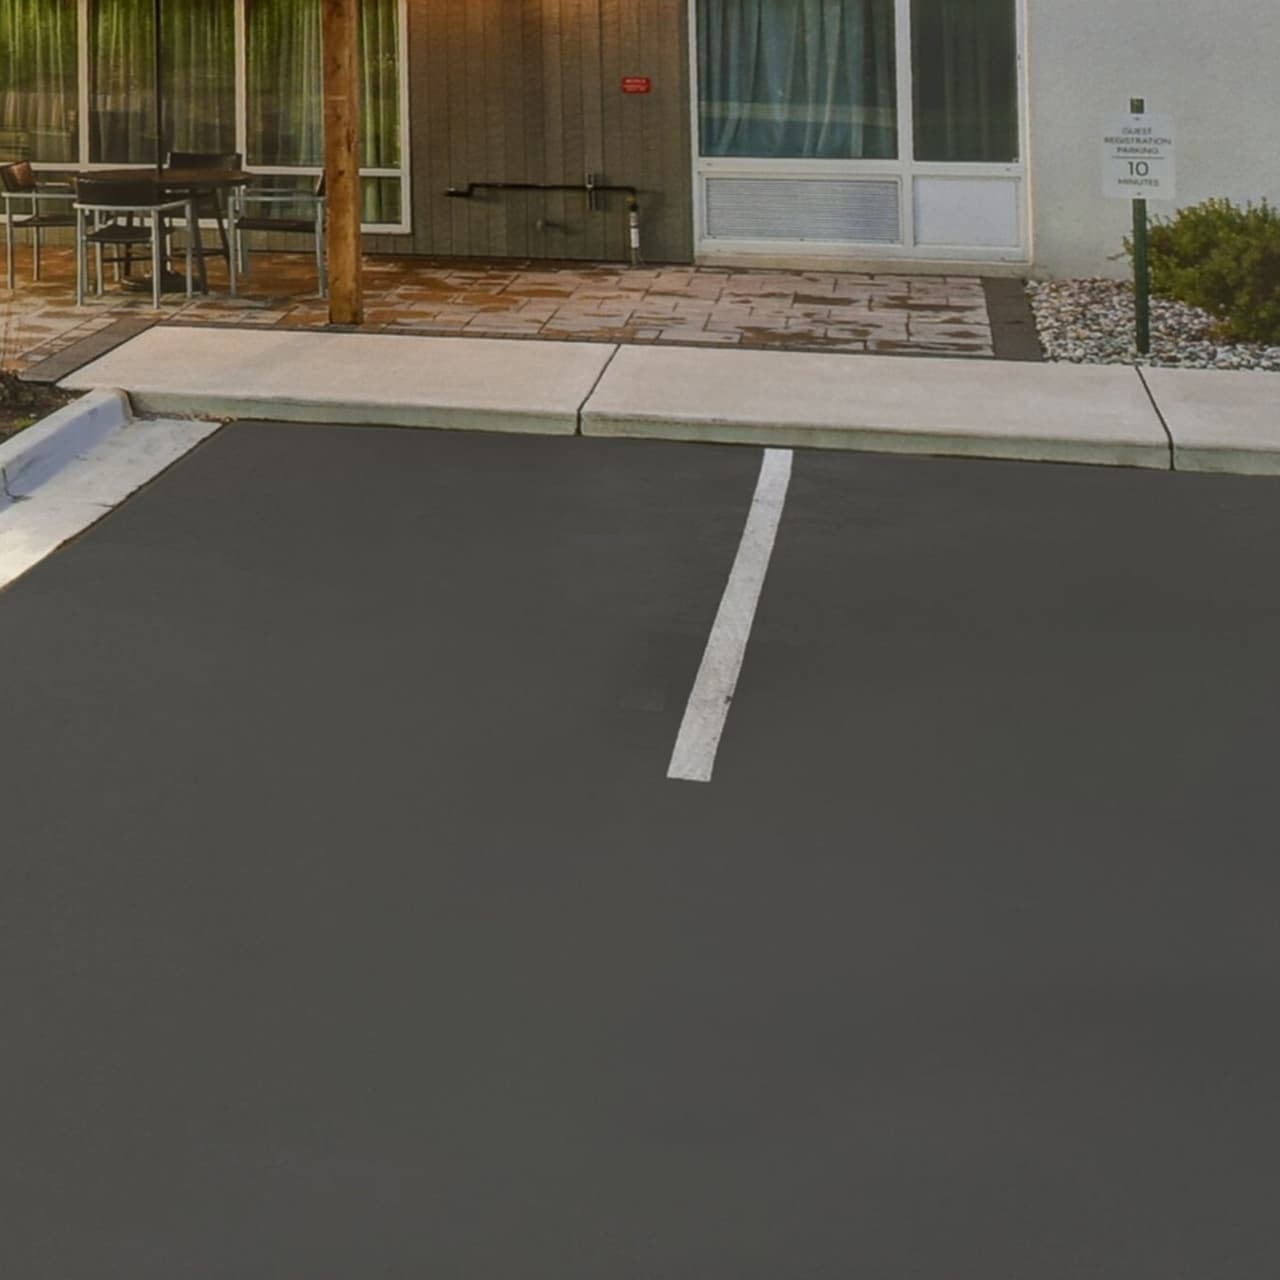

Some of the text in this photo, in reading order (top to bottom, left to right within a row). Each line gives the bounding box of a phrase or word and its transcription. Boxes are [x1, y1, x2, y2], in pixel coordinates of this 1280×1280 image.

[1121, 127, 1152, 135] GUEST
[1128, 161, 1149, 177] 10
[1117, 179, 1159, 187] MINUTES
